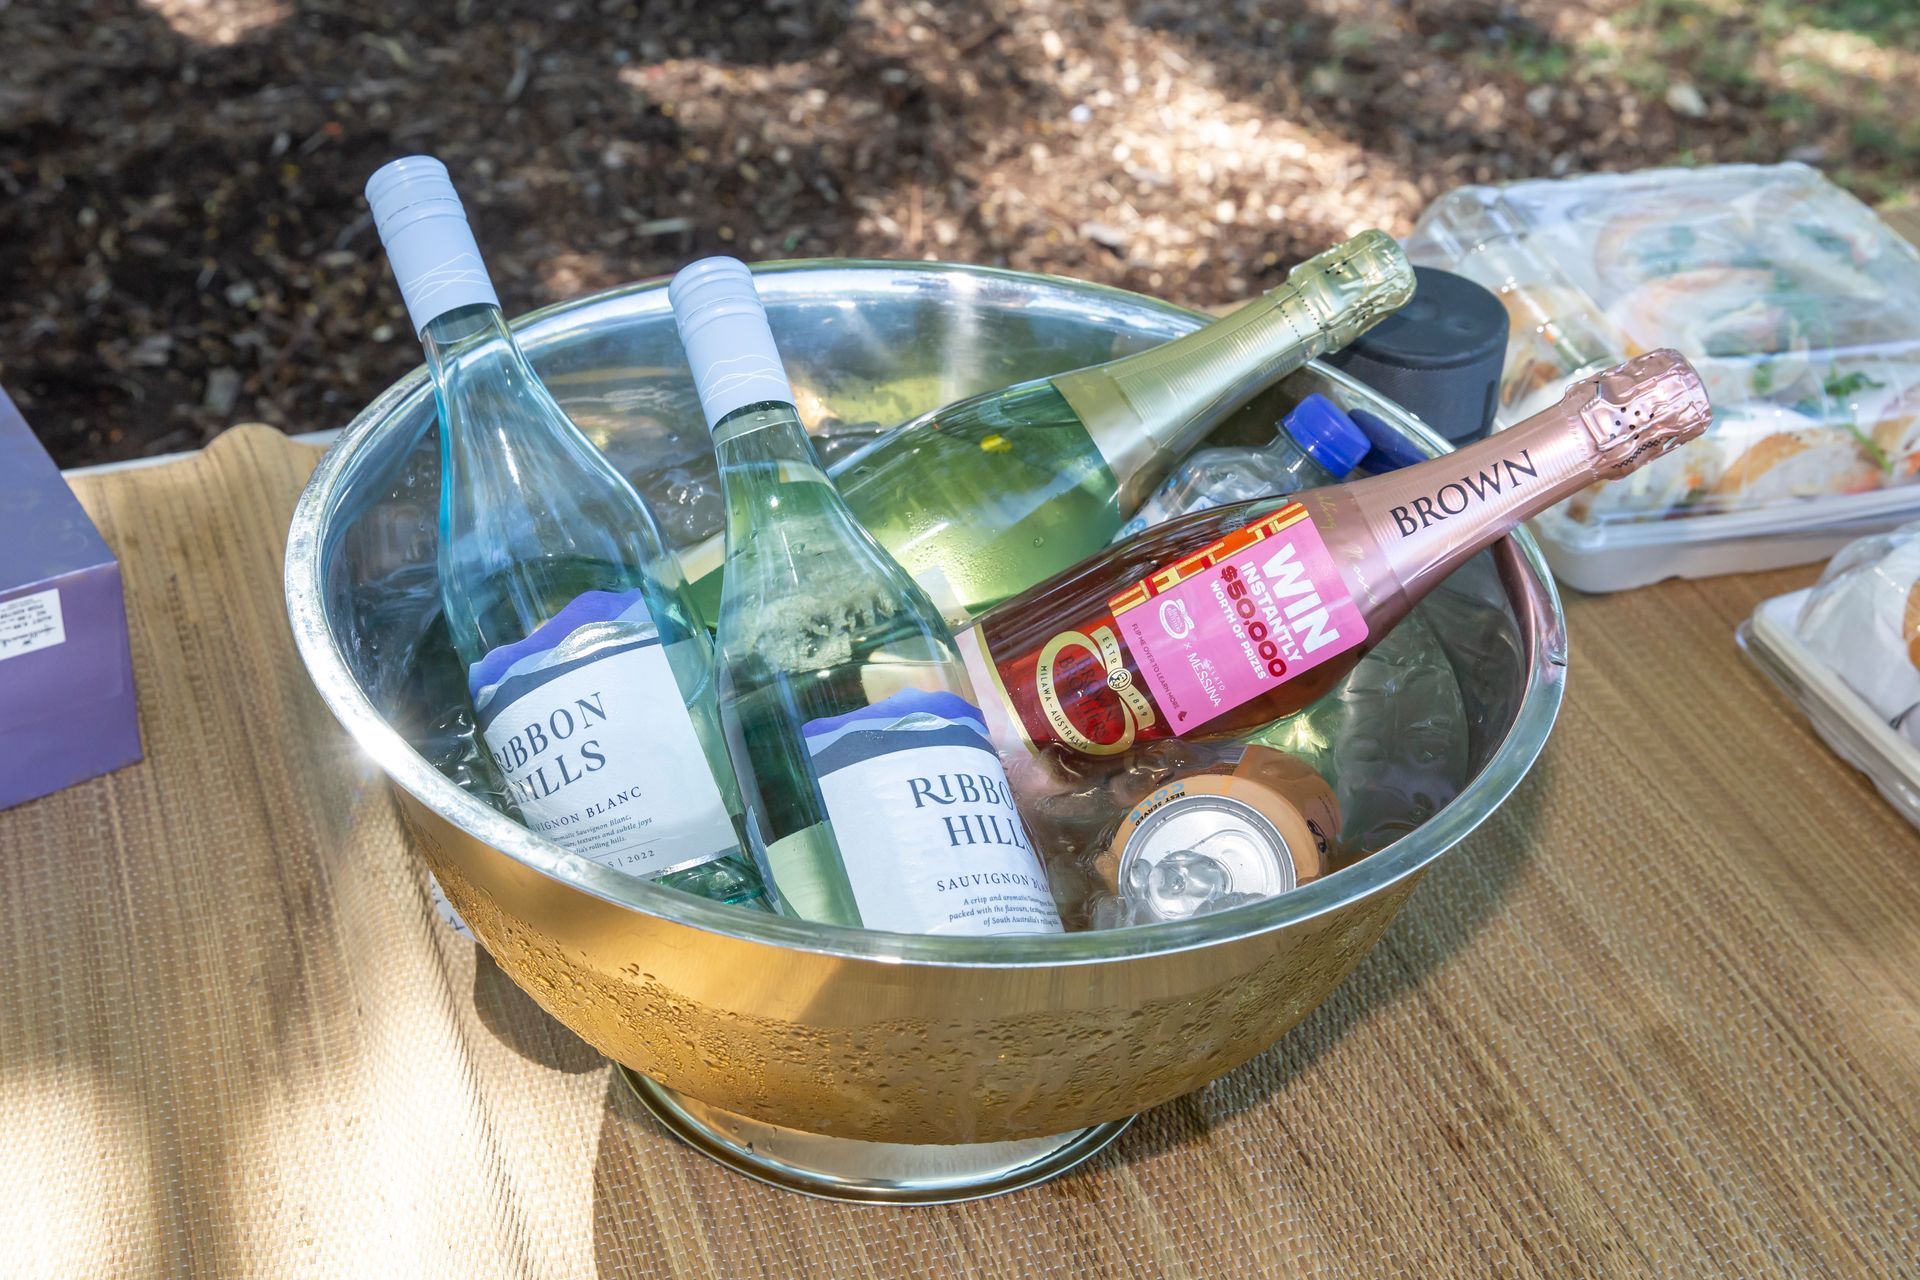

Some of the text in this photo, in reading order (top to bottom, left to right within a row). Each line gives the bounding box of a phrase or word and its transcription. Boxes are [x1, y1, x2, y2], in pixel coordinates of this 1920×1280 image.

[1389, 448, 1538, 538] BROWN
[1209, 579, 1239, 627] WORTH
[1232, 624, 1246, 640] OF
[1262, 542, 1340, 654] WIN
[1220, 565, 1287, 677] $50,000
[1239, 560, 1303, 662] INSTANTLY
[1131, 623, 1143, 640] FLIP
[1143, 646, 1155, 663] OVER
[1152, 662, 1160, 673] TO
[1155, 671, 1171, 693] LEARN
[1187, 652, 1223, 708] MESSINA
[1040, 665, 1088, 751] MILAWA AUSTRALIA
[1128, 692, 1148, 717] 1889
[1166, 689, 1180, 710] MORE
[493, 691, 607, 775] RIBBON
[586, 786, 642, 818] BLANC
[906, 773, 1014, 811] RIBBO
[1135, 791, 1185, 826] BEST SERVED
[575, 821, 609, 838] Sauvignon
[601, 828, 615, 840] and
[616, 822, 637, 834] subtle
[637, 816, 653, 830] joys
[588, 840, 610, 853] rolling
[627, 850, 656, 863] 2022
[936, 872, 1030, 892] SAUVIGNON
[970, 895, 987, 906] crisp
[989, 893, 1002, 901] and
[949, 908, 975, 923] packed
[976, 905, 993, 916] with
[993, 904, 1004, 913] the
[983, 916, 991, 928] of
[991, 916, 1011, 925] South
